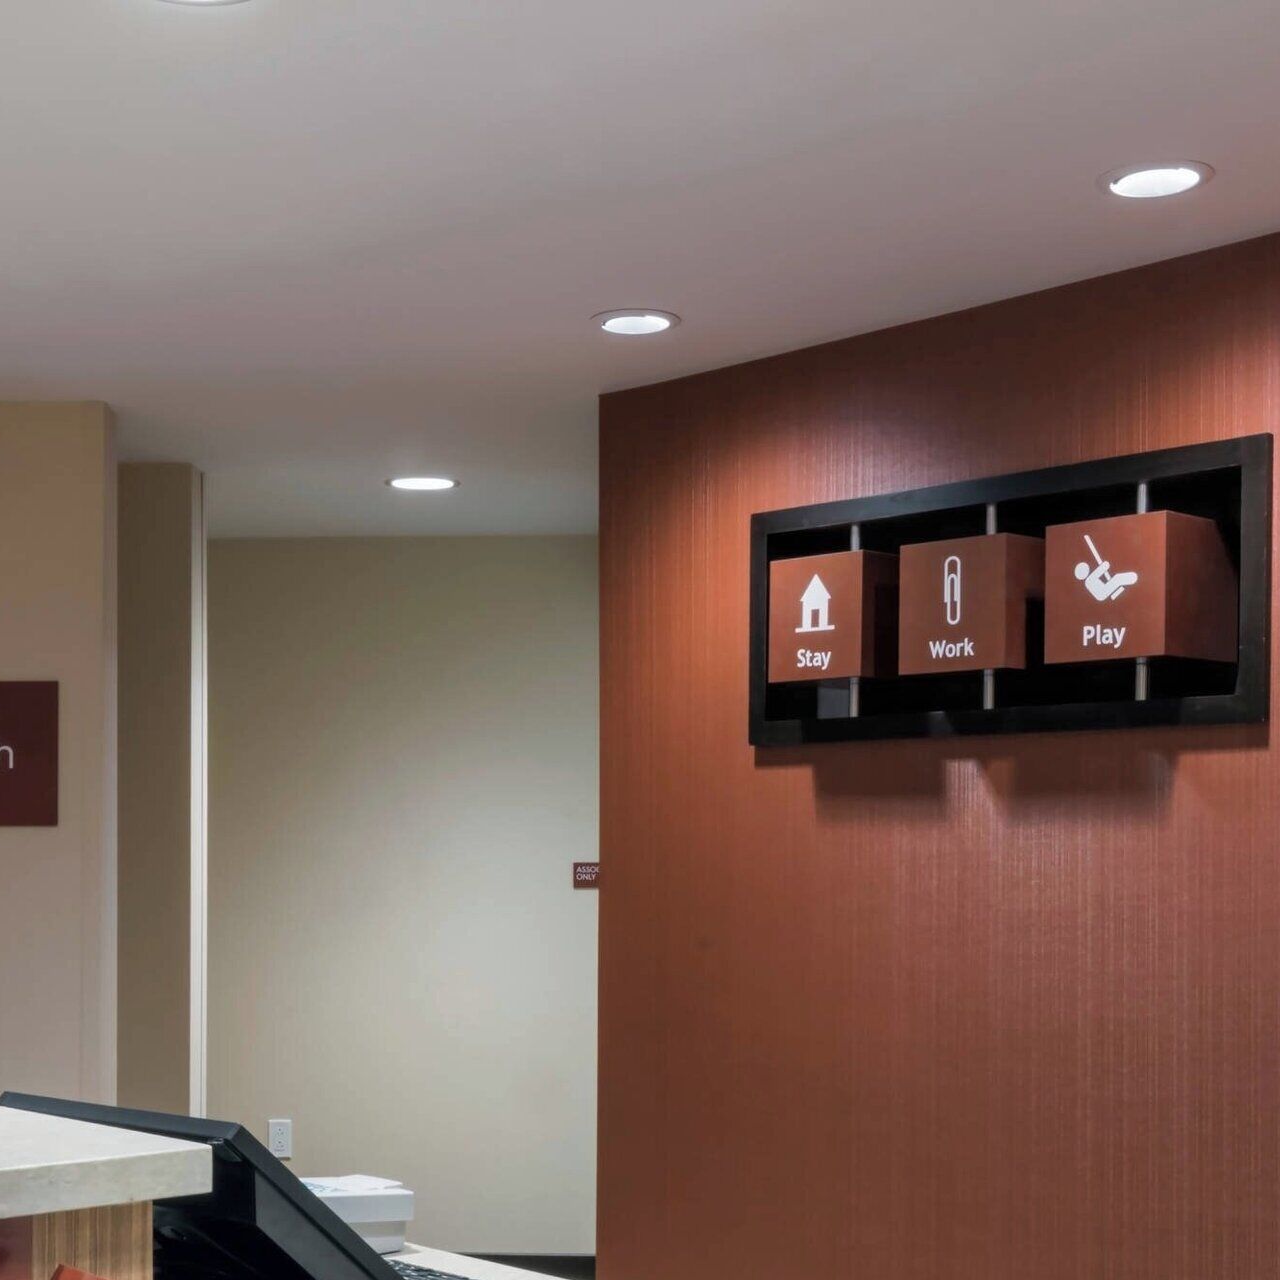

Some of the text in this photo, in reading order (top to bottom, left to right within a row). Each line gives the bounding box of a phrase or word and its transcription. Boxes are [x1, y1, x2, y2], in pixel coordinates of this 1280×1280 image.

[1082, 624, 1127, 649] Play
[796, 647, 832, 670] Stay
[929, 638, 975, 660] Work
